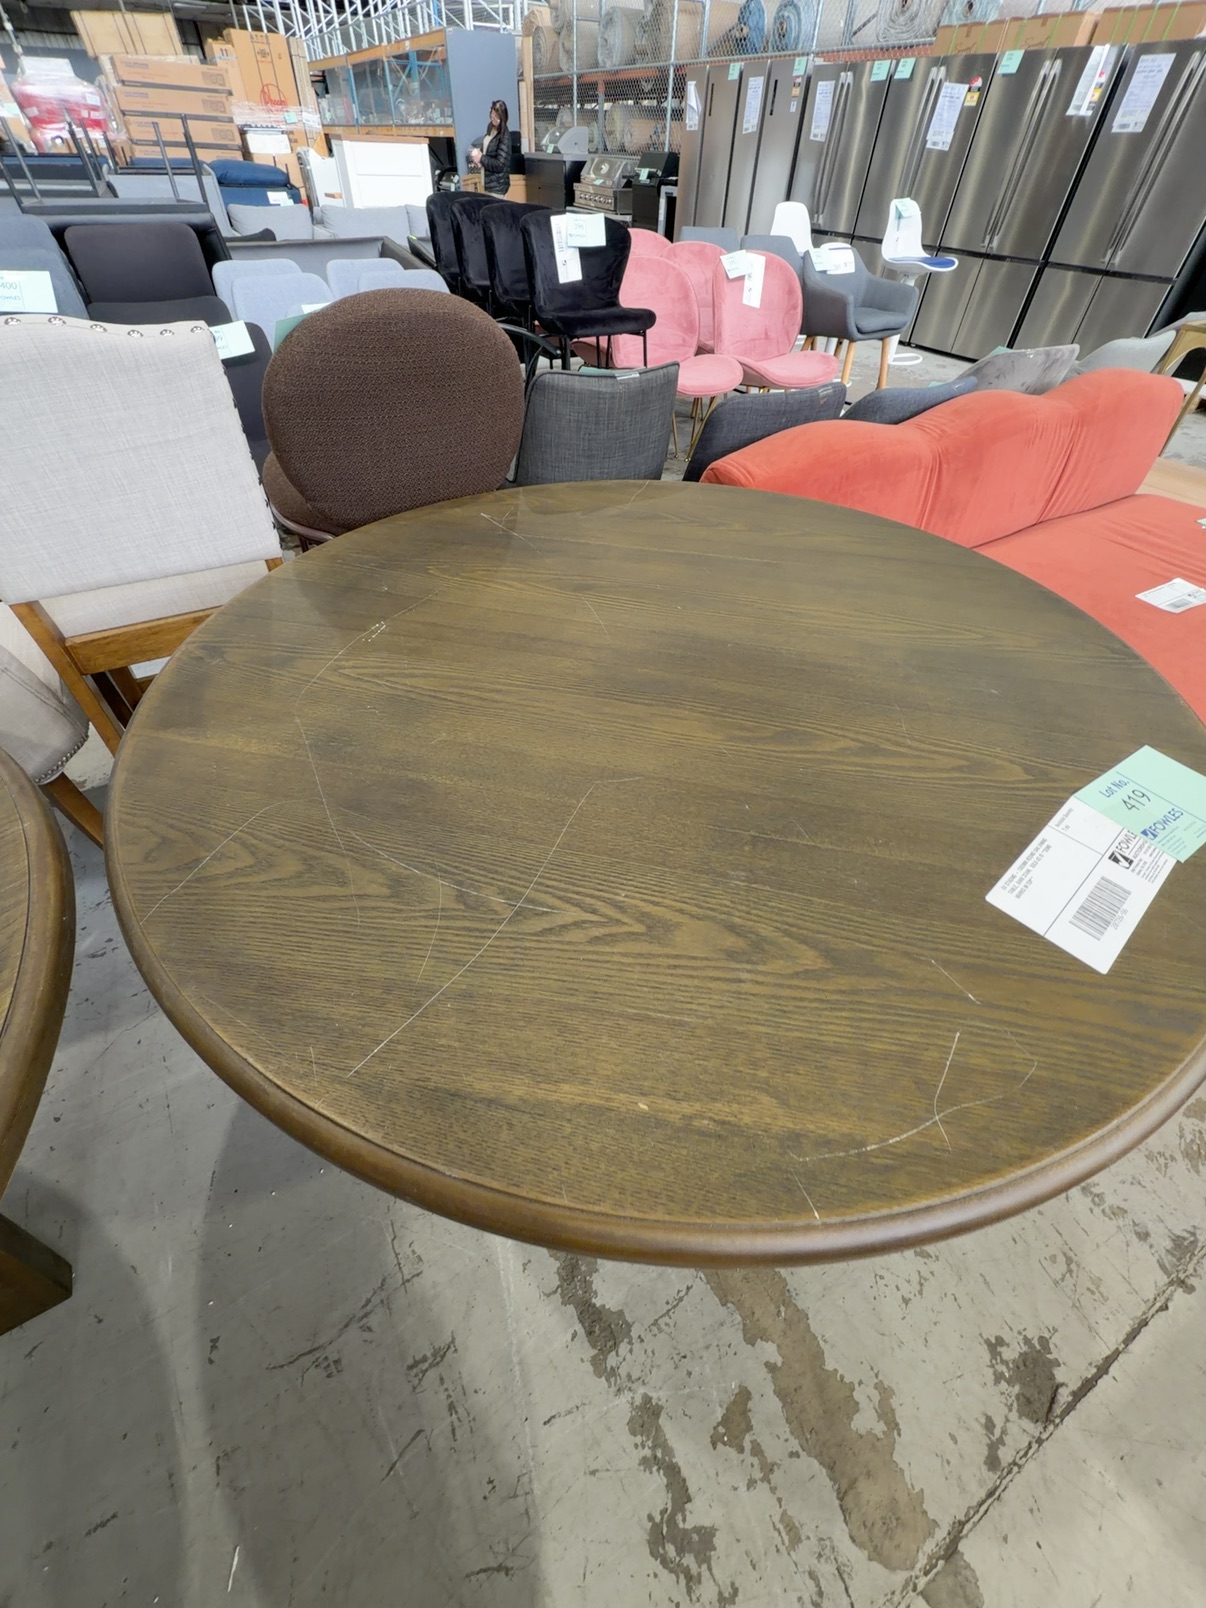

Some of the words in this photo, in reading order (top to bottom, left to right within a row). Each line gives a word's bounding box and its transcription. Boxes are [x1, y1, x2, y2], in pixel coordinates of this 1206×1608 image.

[1099, 784, 1115, 798] Lot
[1122, 789, 1151, 813] 419
[1150, 808, 1184, 836] FOWLES
[1116, 830, 1137, 853] FOWLE
